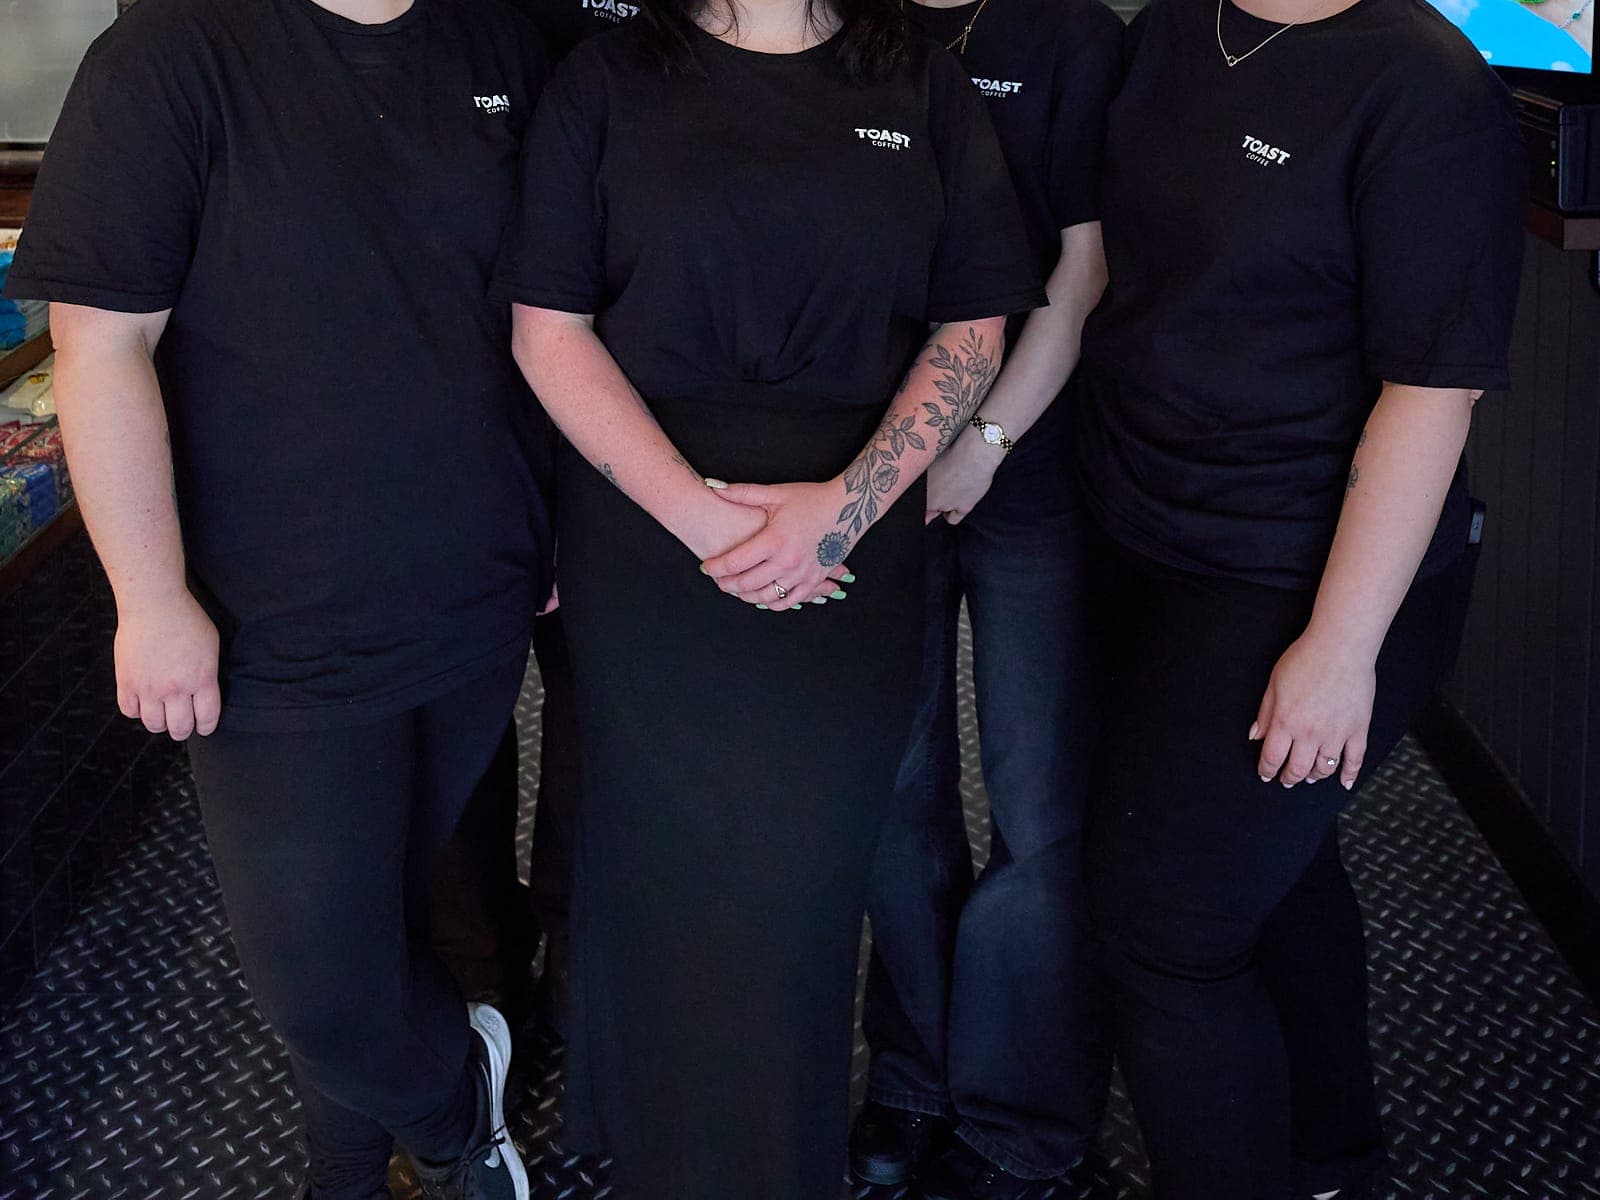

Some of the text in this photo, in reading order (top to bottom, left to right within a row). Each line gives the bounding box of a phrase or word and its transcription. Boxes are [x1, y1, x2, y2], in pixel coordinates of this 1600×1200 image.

[971, 77, 1023, 93] TOAST
[473, 94, 510, 108] TOAS
[854, 128, 911, 149] TOAST
[872, 140, 901, 151] COFFEE
[1242, 135, 1291, 165] TOAST
[1246, 152, 1270, 167] COFFEE
